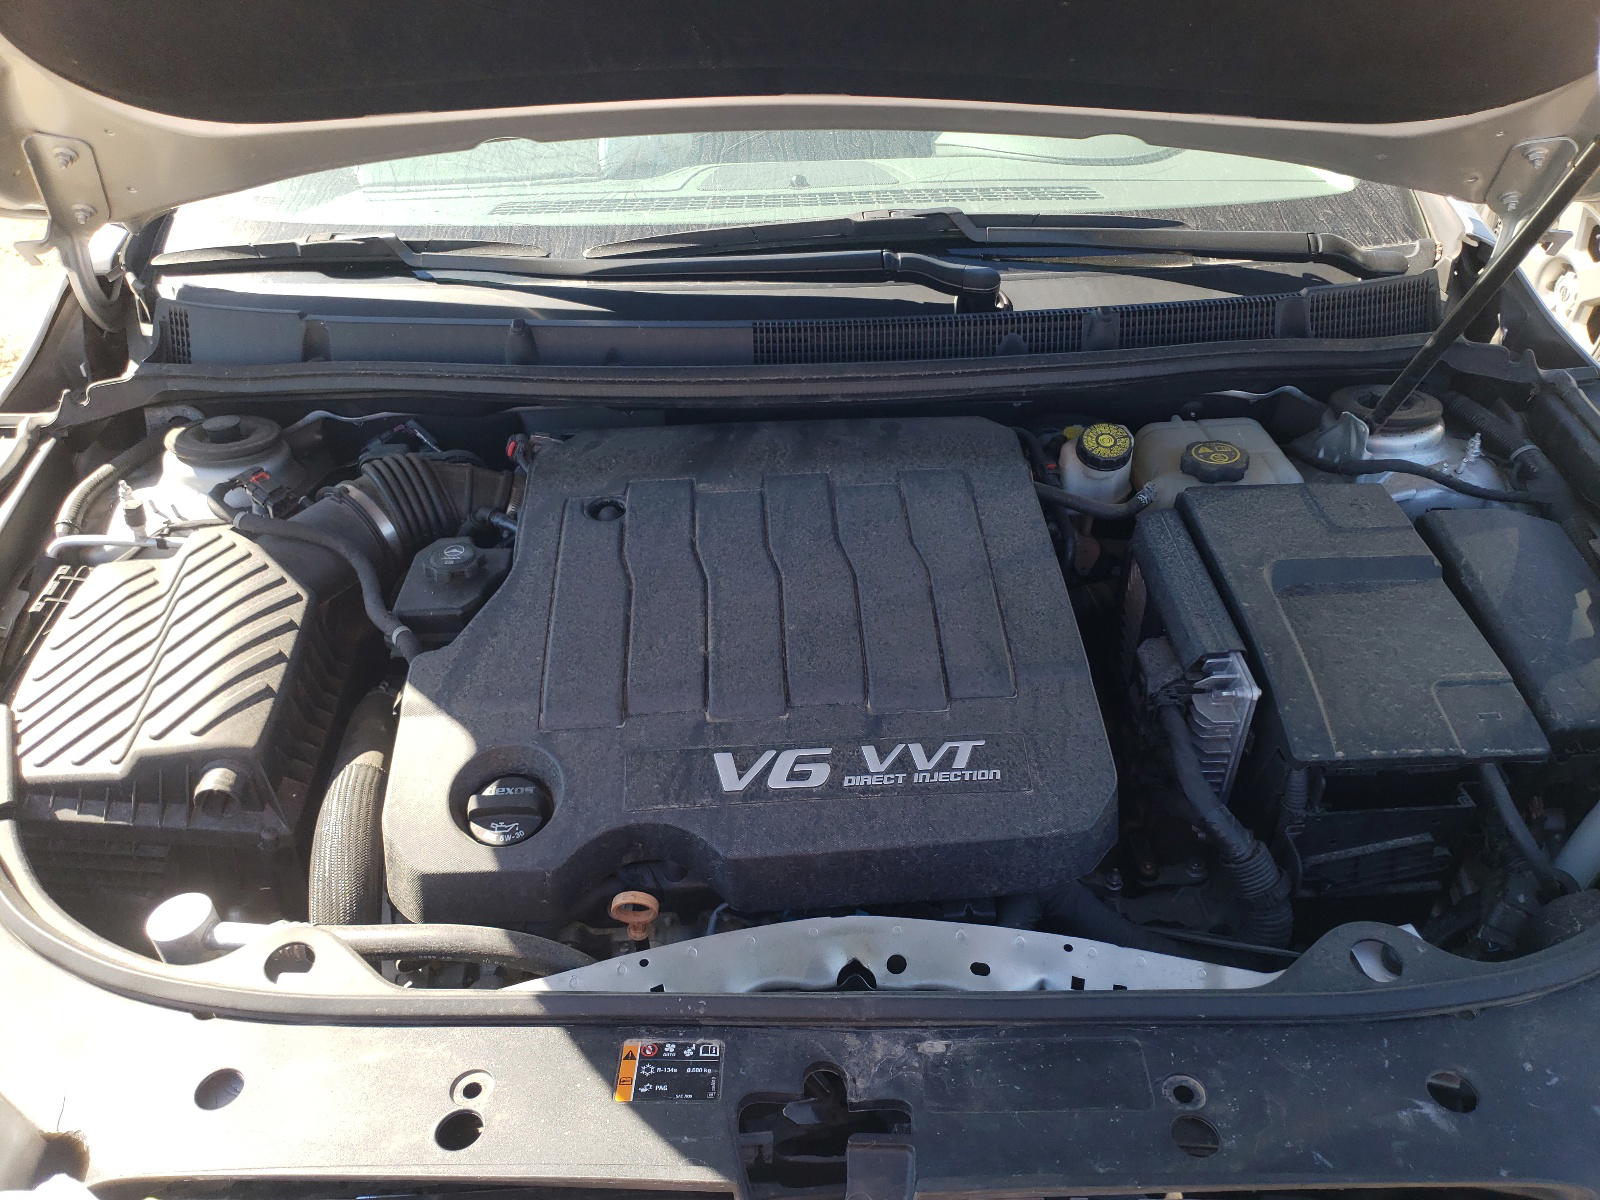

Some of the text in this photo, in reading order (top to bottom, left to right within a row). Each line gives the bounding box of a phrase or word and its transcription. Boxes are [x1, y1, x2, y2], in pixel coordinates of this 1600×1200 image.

[713, 739, 986, 792] V6 VVT
[843, 769, 1001, 788] DIRECT INJECTION
[488, 785, 536, 795] dexos
